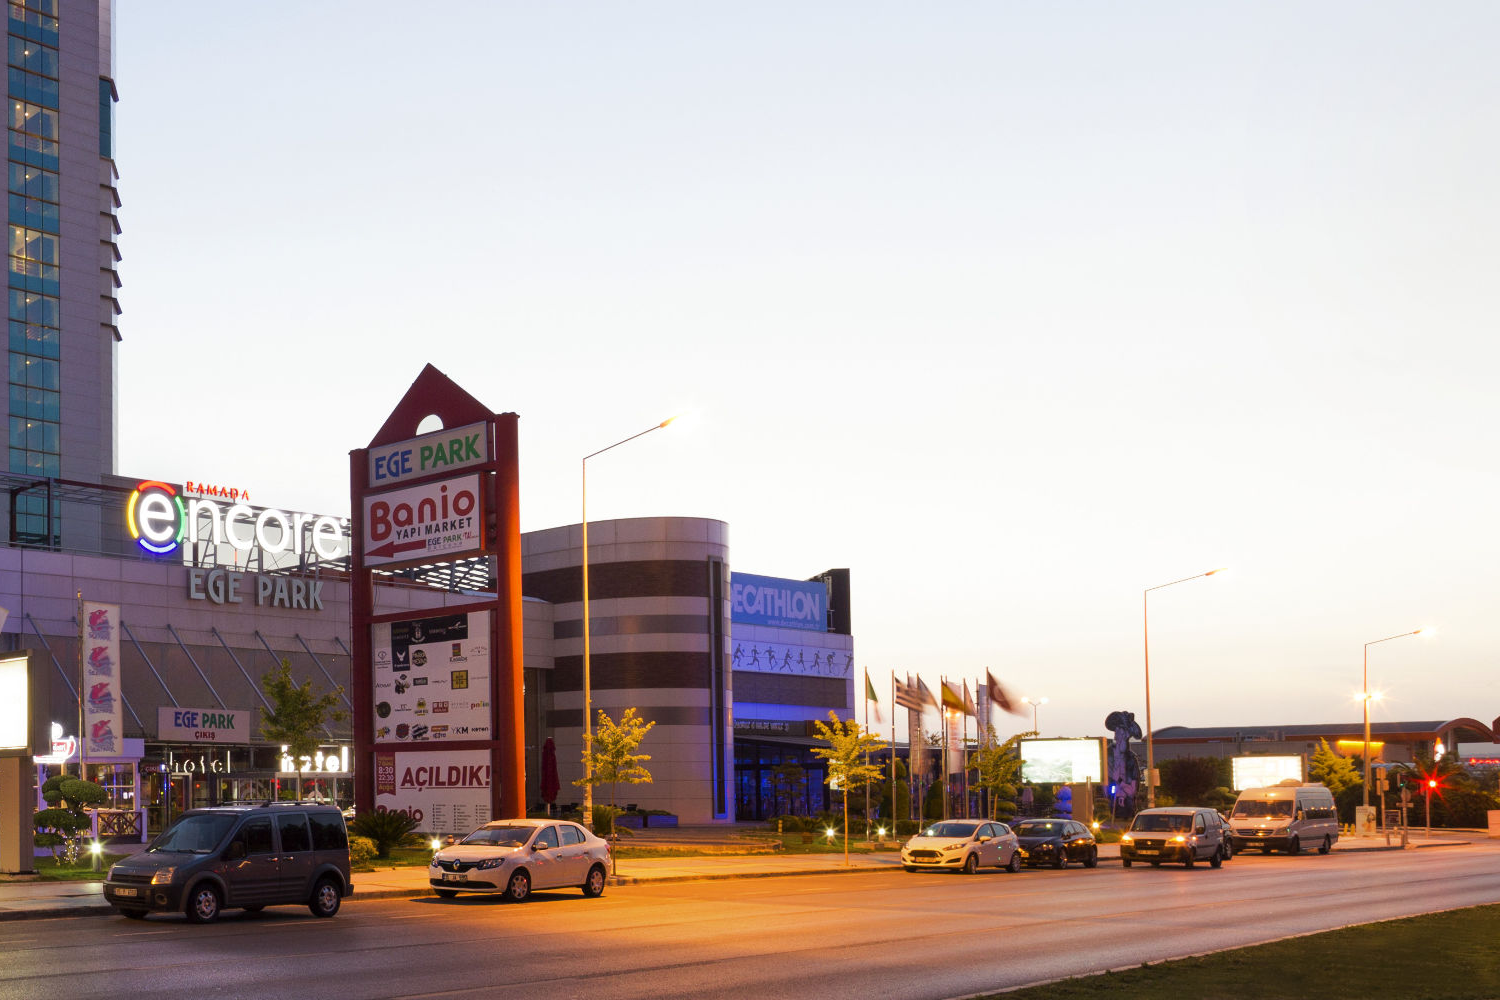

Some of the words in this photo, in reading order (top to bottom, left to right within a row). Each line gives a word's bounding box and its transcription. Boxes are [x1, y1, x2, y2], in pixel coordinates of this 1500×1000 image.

[375, 450, 413, 480] EGE
[420, 433, 481, 471] PARK
[187, 481, 249, 501] RAMADA
[370, 484, 475, 541] Banio
[138, 492, 343, 560] encore
[396, 526, 421, 541] YAPI
[425, 517, 473, 535] MARKET
[427, 537, 441, 546] EGE
[443, 533, 462, 543] PARK
[188, 568, 243, 605] EGE
[256, 576, 325, 611] PARK
[731, 584, 820, 621] ECATHLON
[174, 711, 198, 728] EGE
[202, 713, 235, 729] PARK
[451, 727, 469, 735] YKM
[194, 731, 216, 740] ÇIKIŞ
[400, 765, 491, 791] AÇILDIK!
